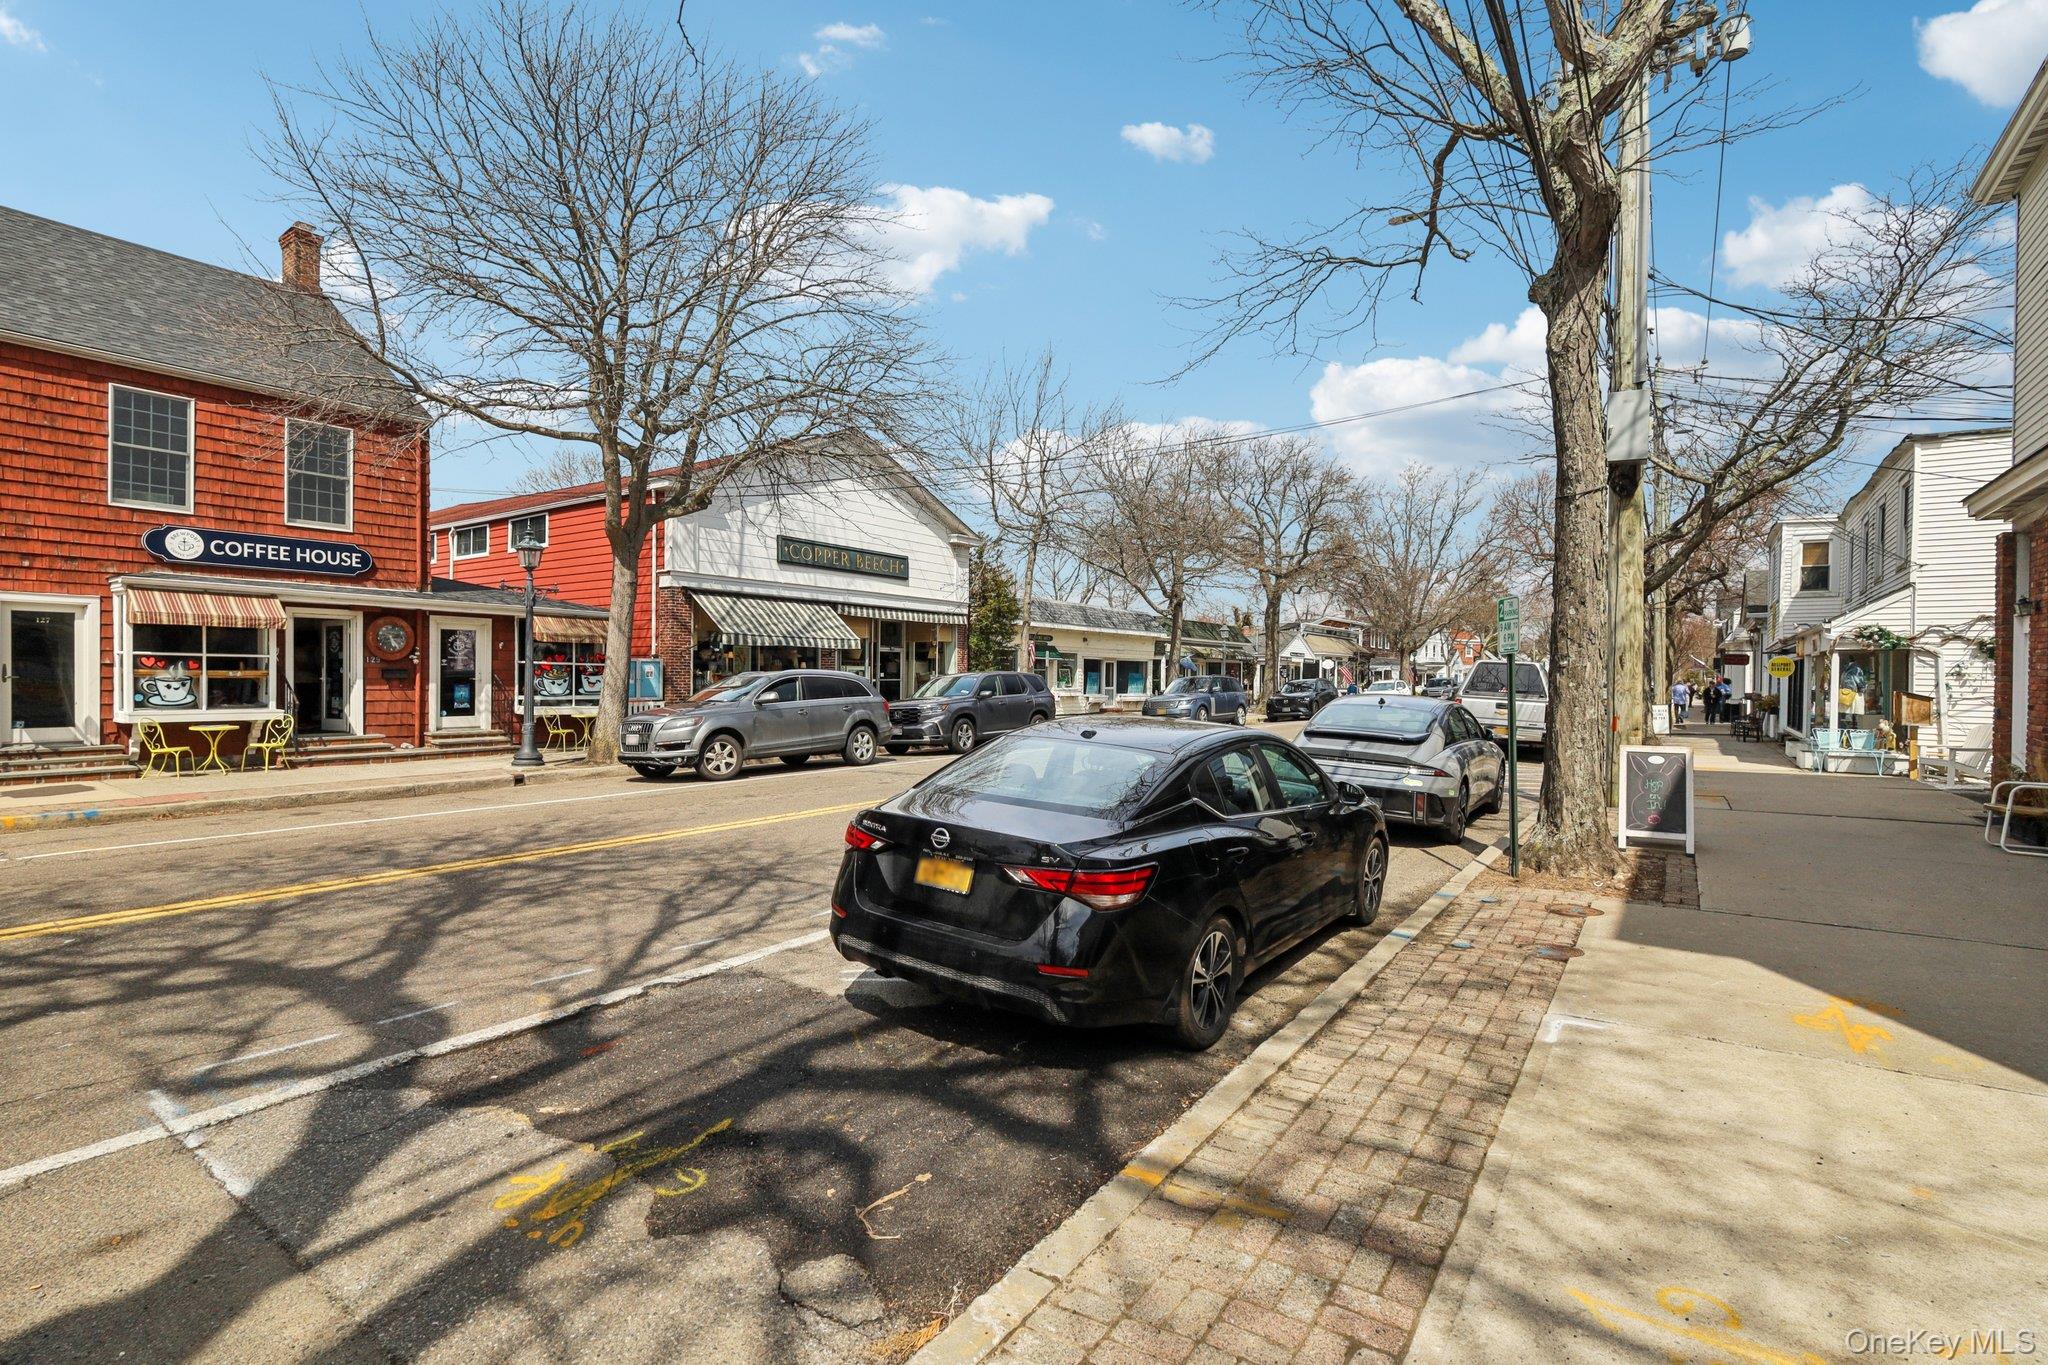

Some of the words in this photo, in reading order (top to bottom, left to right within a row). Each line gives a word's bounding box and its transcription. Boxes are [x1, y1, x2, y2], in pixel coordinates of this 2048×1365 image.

[210, 539, 290, 561] COFFEE
[296, 548, 362, 568] HOUSE
[789, 544, 849, 567] COPPER
[856, 553, 899, 573] BEECH
[1499, 603, 1504, 618] 2
[1504, 622, 1512, 631] AM
[1508, 632, 1514, 642] PM
[1644, 779, 1664, 793] Hop
[862, 819, 887, 833] SENTRA
[1041, 856, 1060, 864] SV
